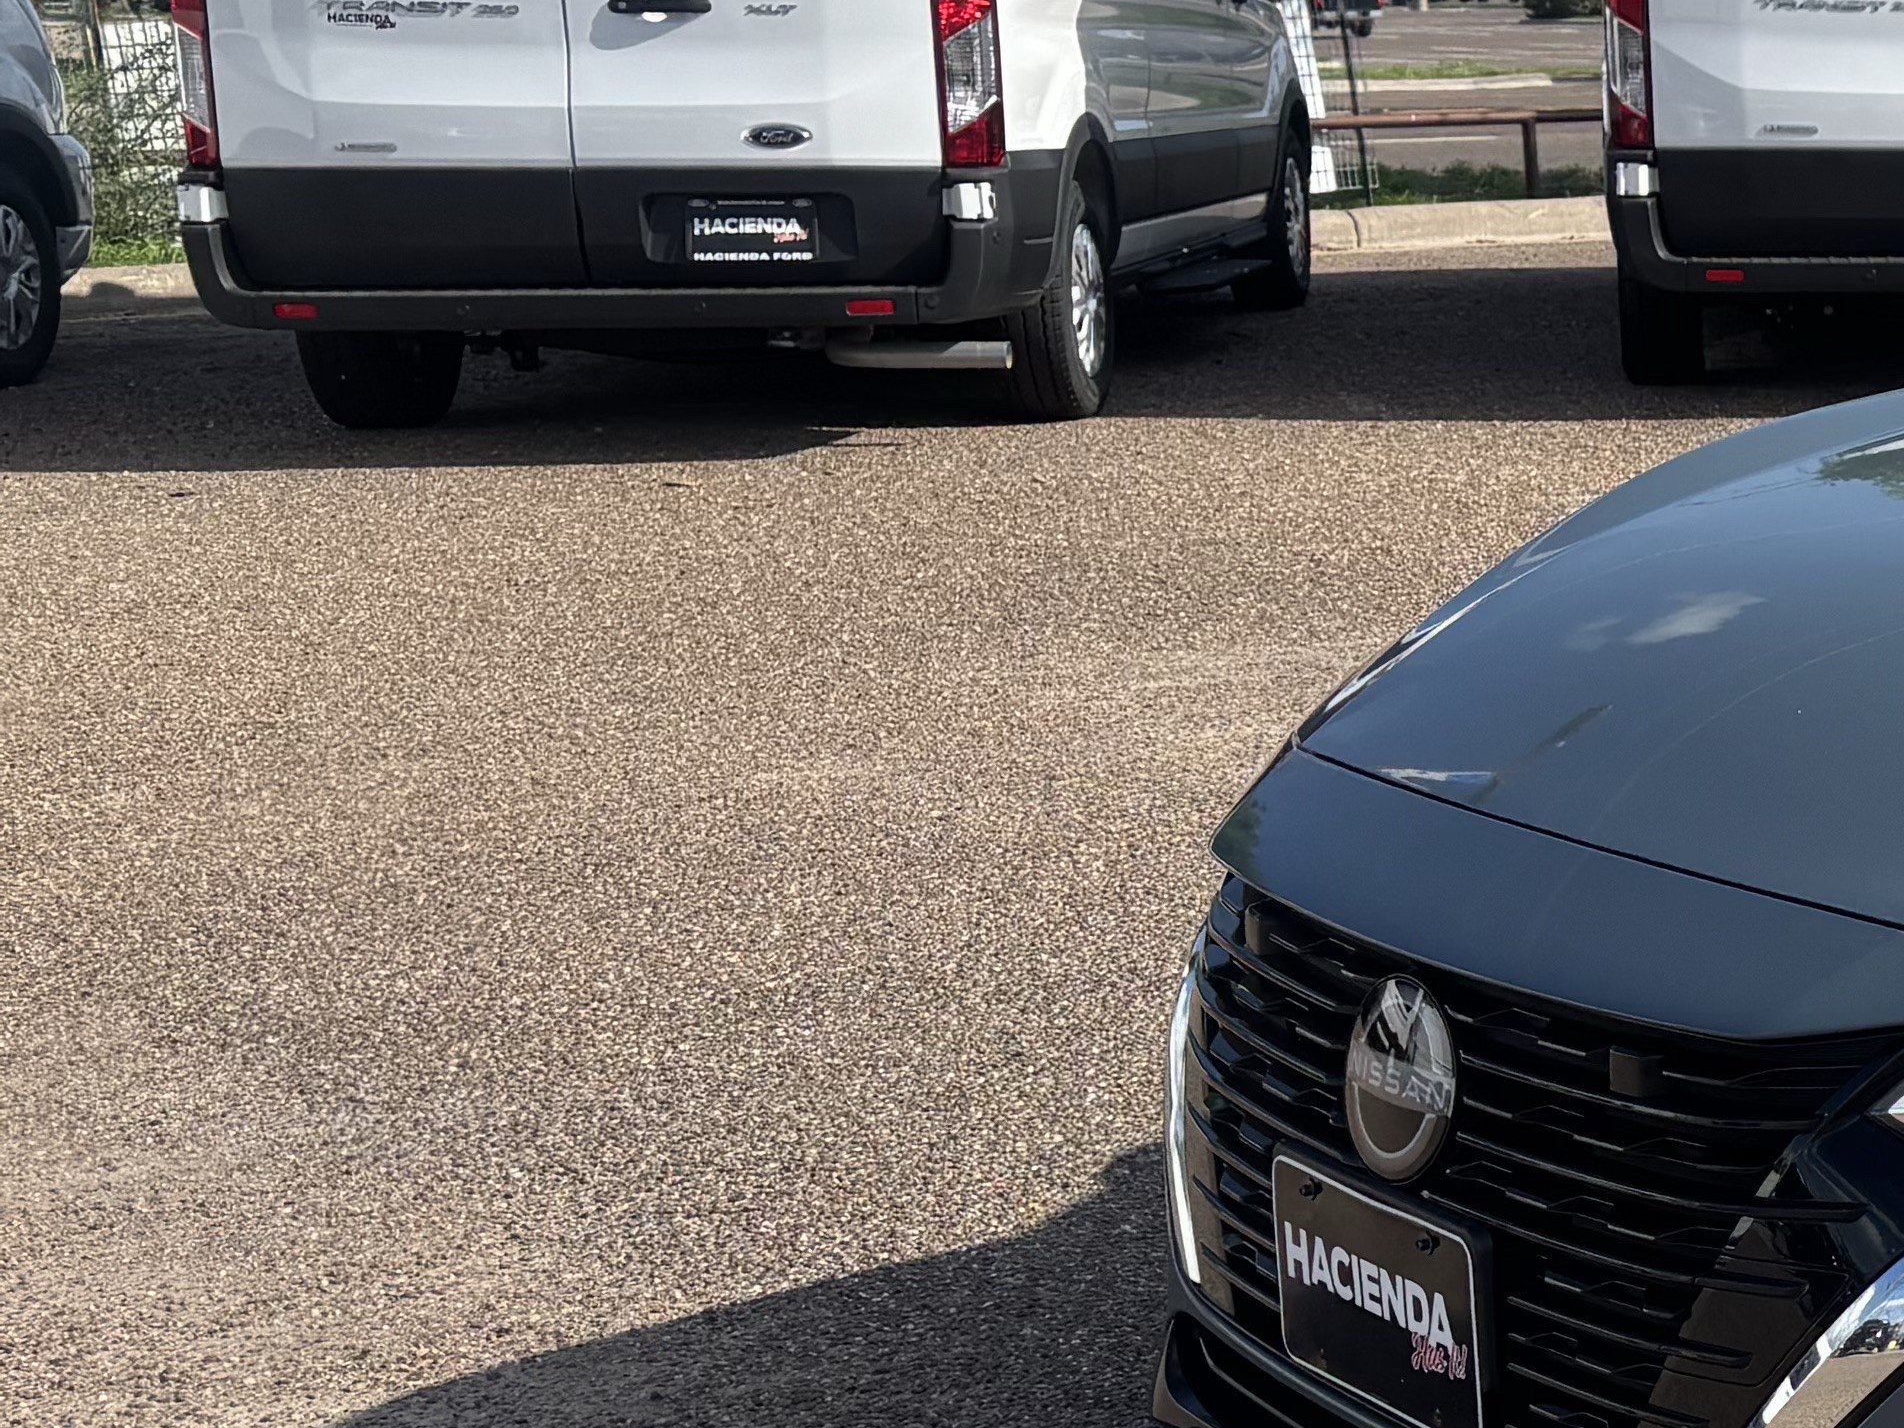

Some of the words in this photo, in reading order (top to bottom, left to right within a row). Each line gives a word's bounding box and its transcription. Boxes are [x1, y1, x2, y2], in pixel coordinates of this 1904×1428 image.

[743, 3, 797, 17] XLT
[327, 12, 392, 25] HACIENDA
[693, 217, 801, 236] HACIENDA
[694, 252, 770, 262] HACIENDA
[1348, 1050, 1452, 1112] NISSAN
[1283, 1220, 1455, 1355] HACIENDA
